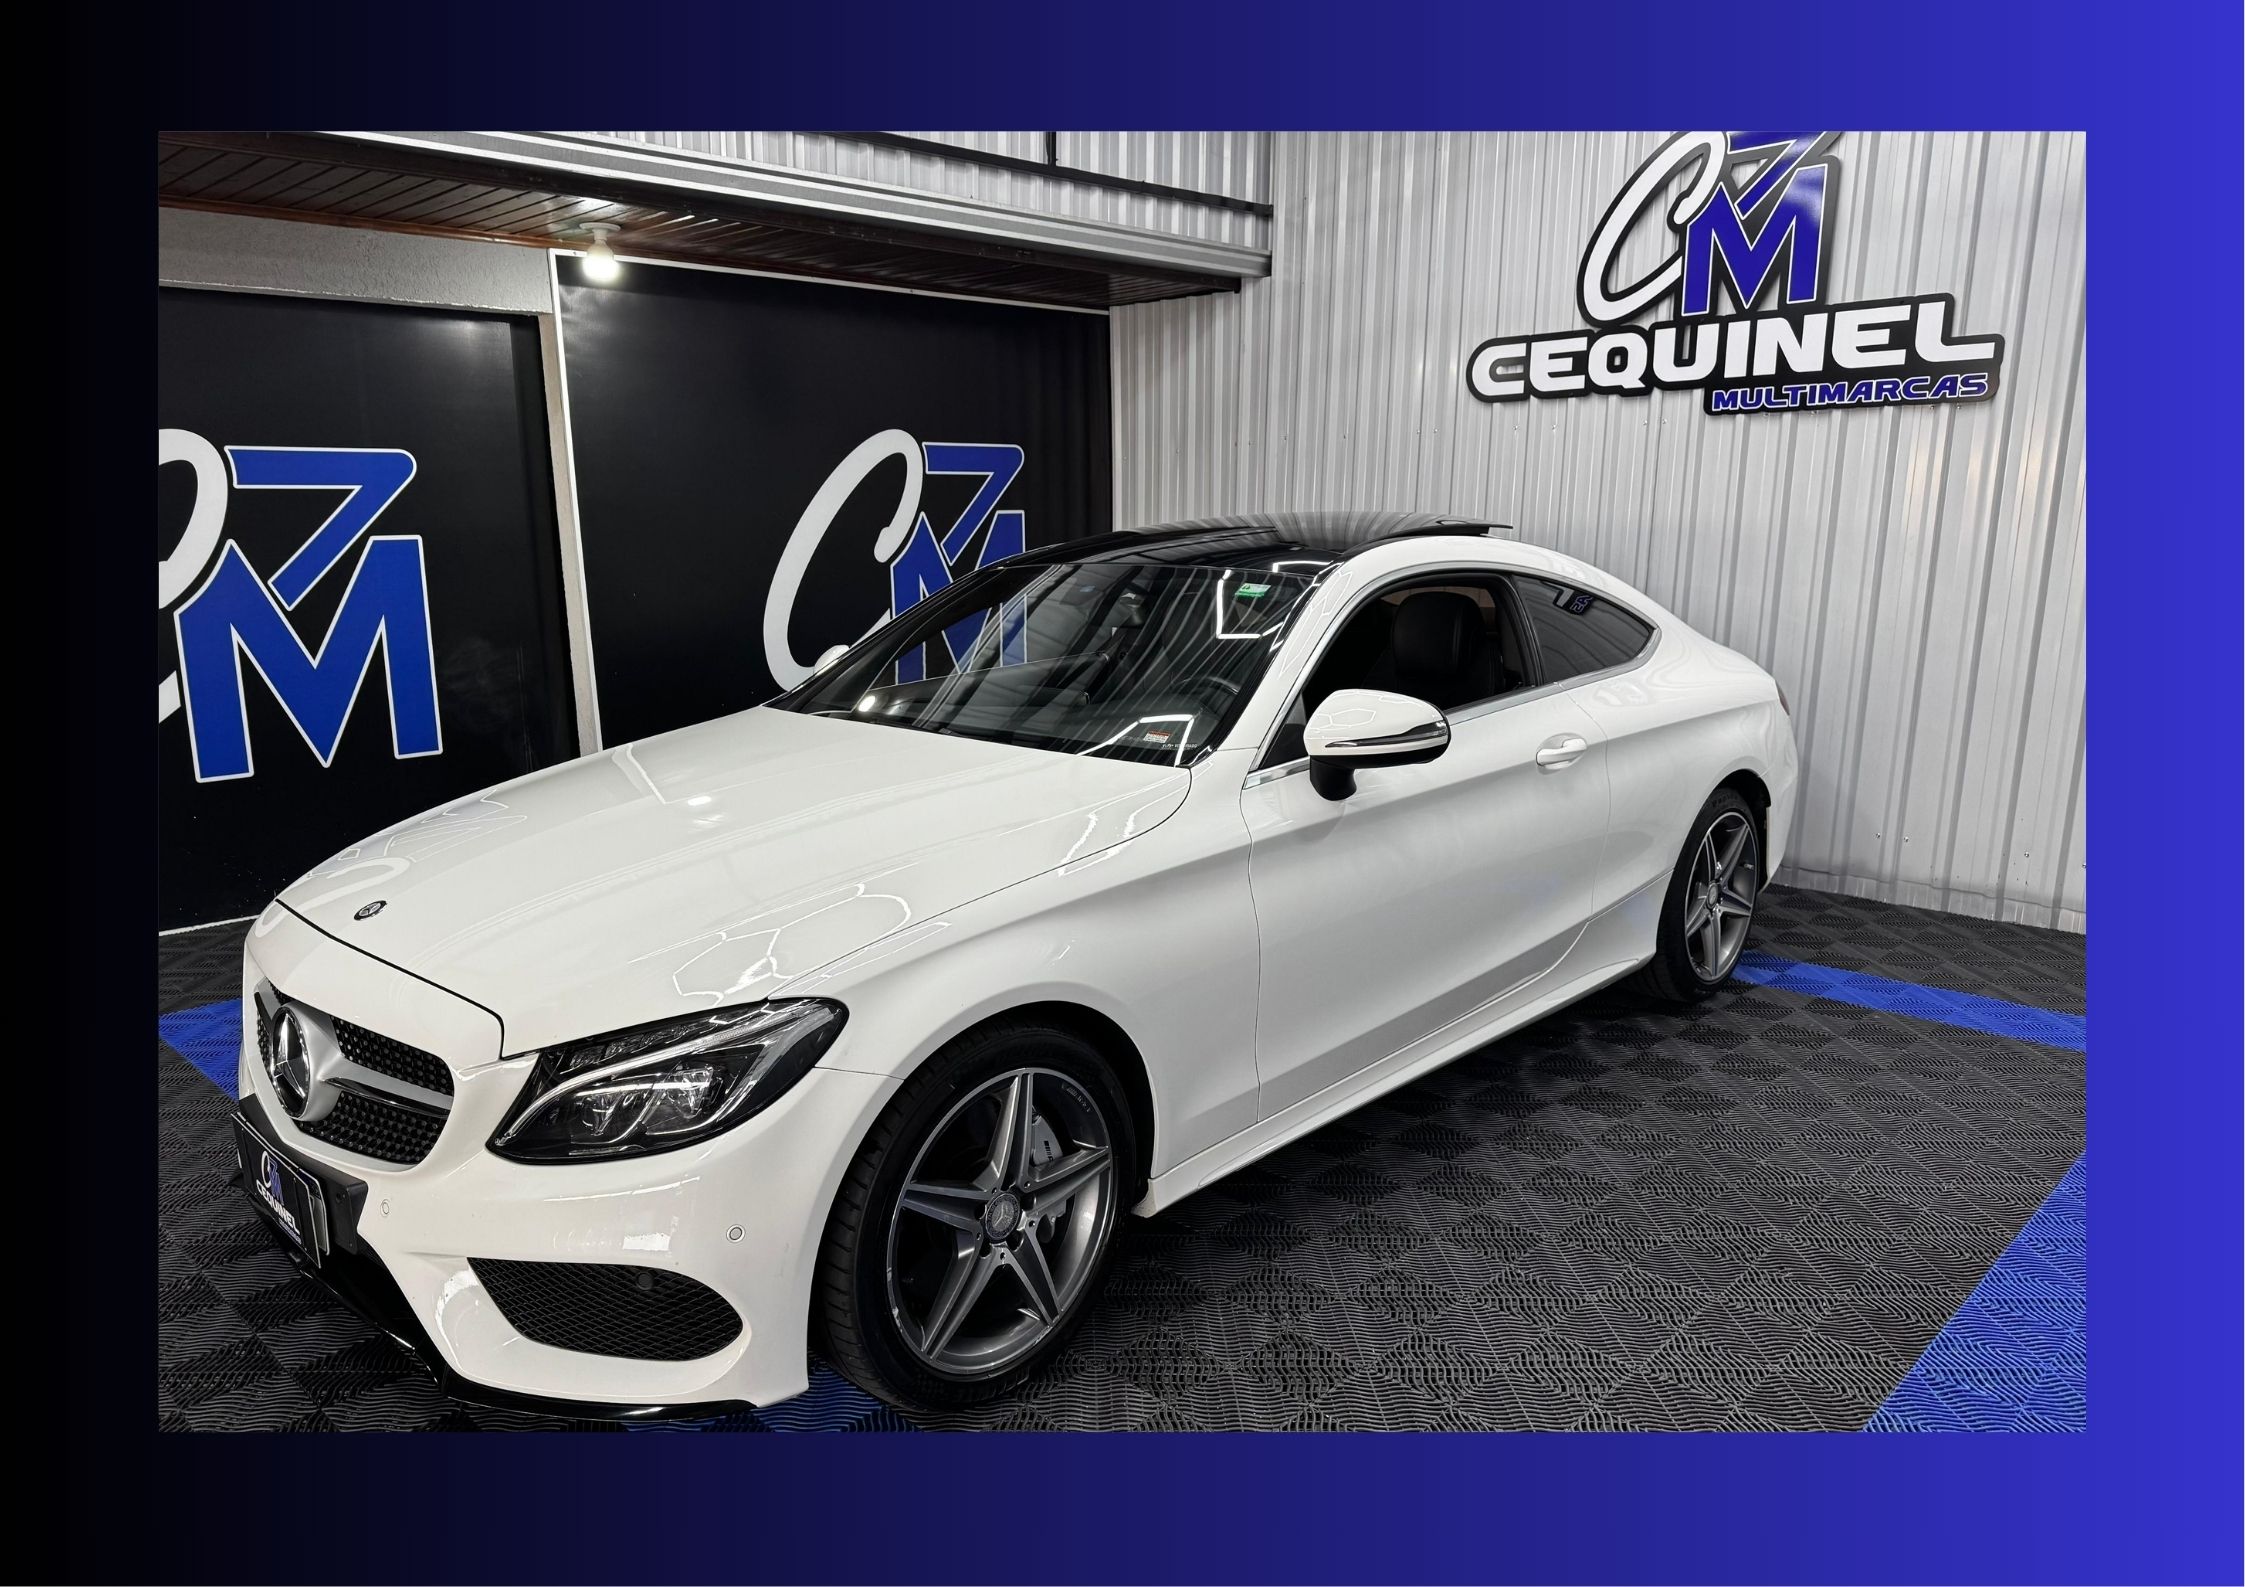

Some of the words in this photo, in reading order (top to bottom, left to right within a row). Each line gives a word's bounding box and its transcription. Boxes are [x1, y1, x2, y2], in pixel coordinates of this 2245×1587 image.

[1471, 301, 1996, 397] CEQUINEL
[1711, 374, 1989, 412] MULTIMARCAS
[256, 1179, 300, 1235] CEQUINEL
